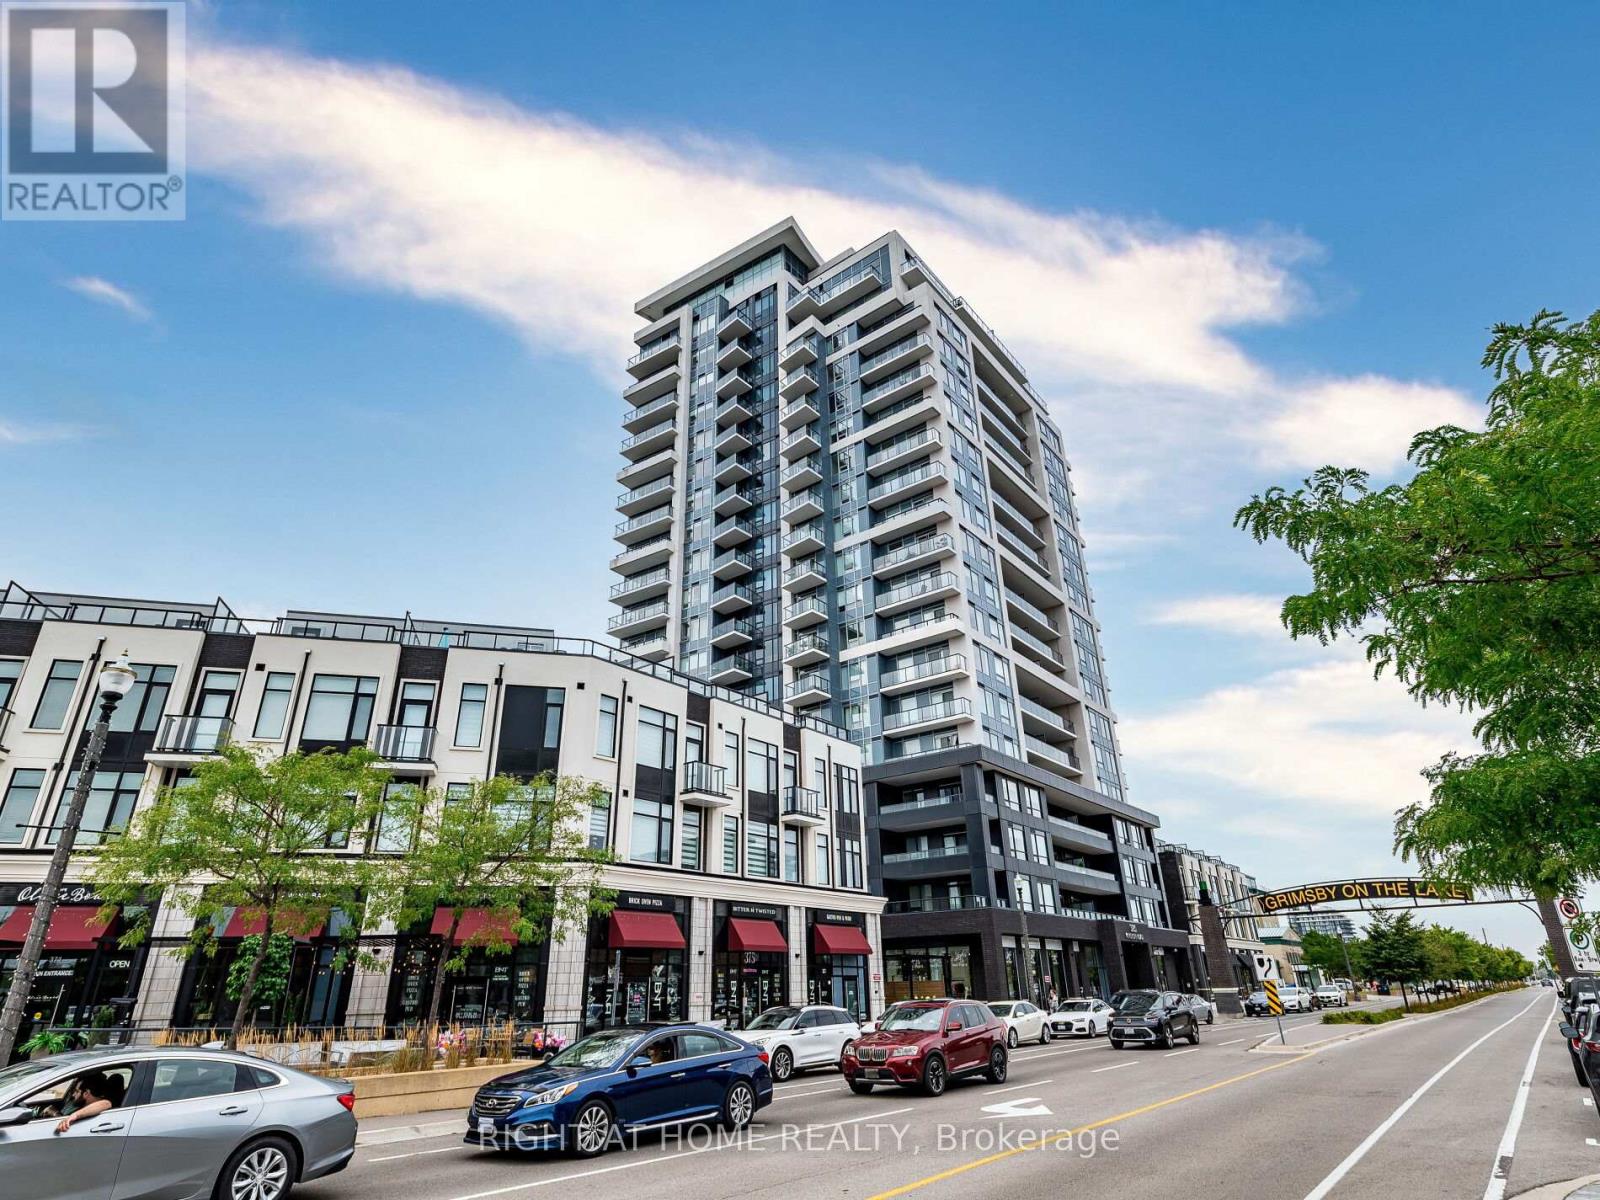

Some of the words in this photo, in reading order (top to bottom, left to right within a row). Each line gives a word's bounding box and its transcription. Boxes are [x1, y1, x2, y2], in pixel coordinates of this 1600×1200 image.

[1264, 886, 1337, 910] GRIMSBY
[1342, 884, 1369, 898] ON
[1372, 882, 1410, 897] THE
[109, 960, 131, 968] OPEN
